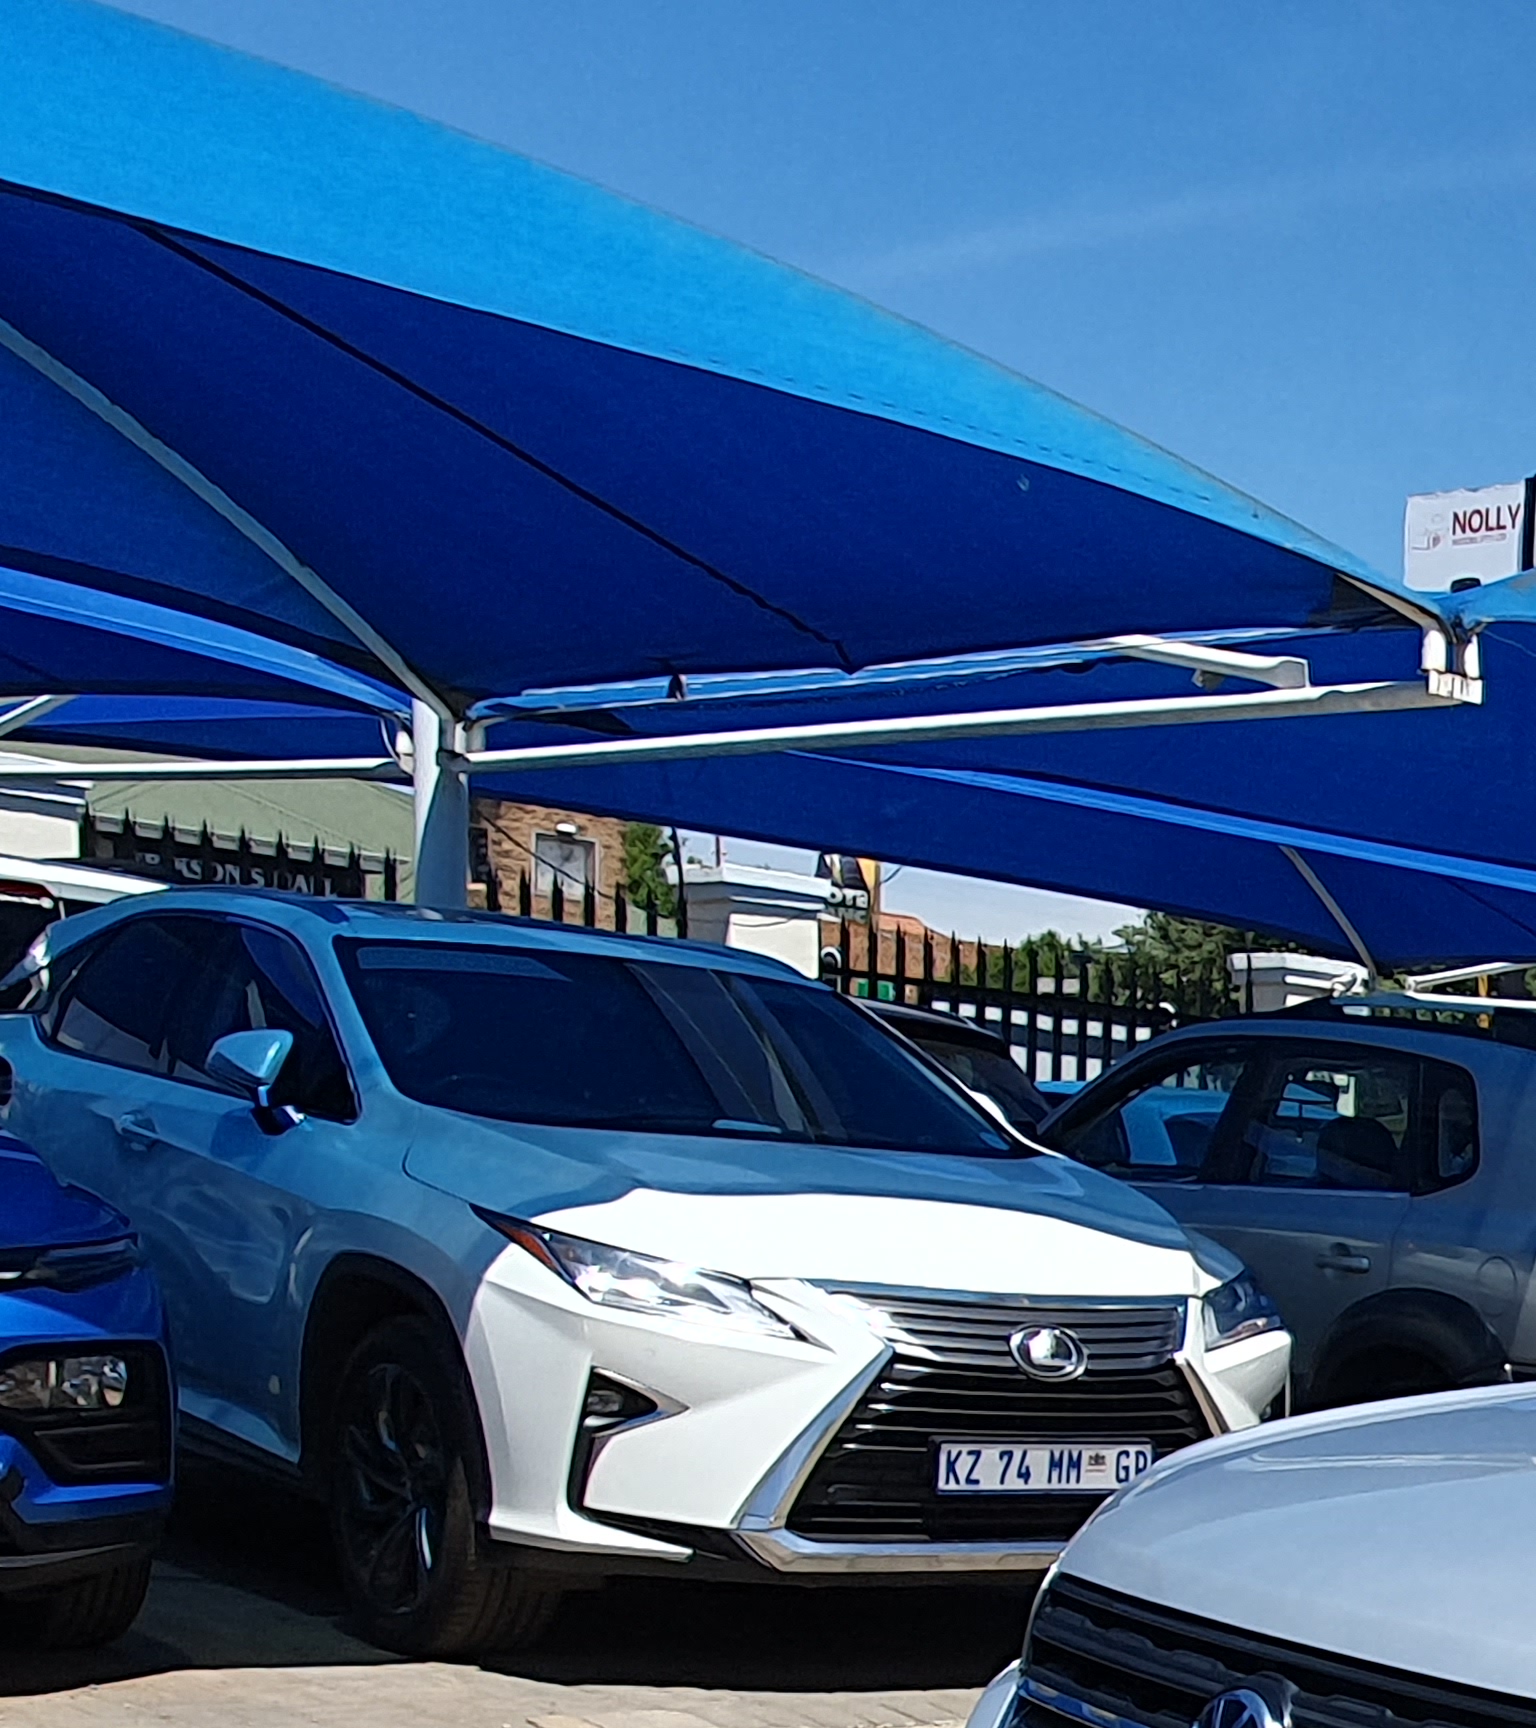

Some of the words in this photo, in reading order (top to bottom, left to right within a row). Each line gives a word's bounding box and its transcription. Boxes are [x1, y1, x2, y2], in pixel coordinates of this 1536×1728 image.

[1451, 502, 1521, 536] NOLLY
[945, 1449, 982, 1486] KZ
[998, 1449, 1032, 1486] 74
[1047, 1449, 1083, 1485] MM
